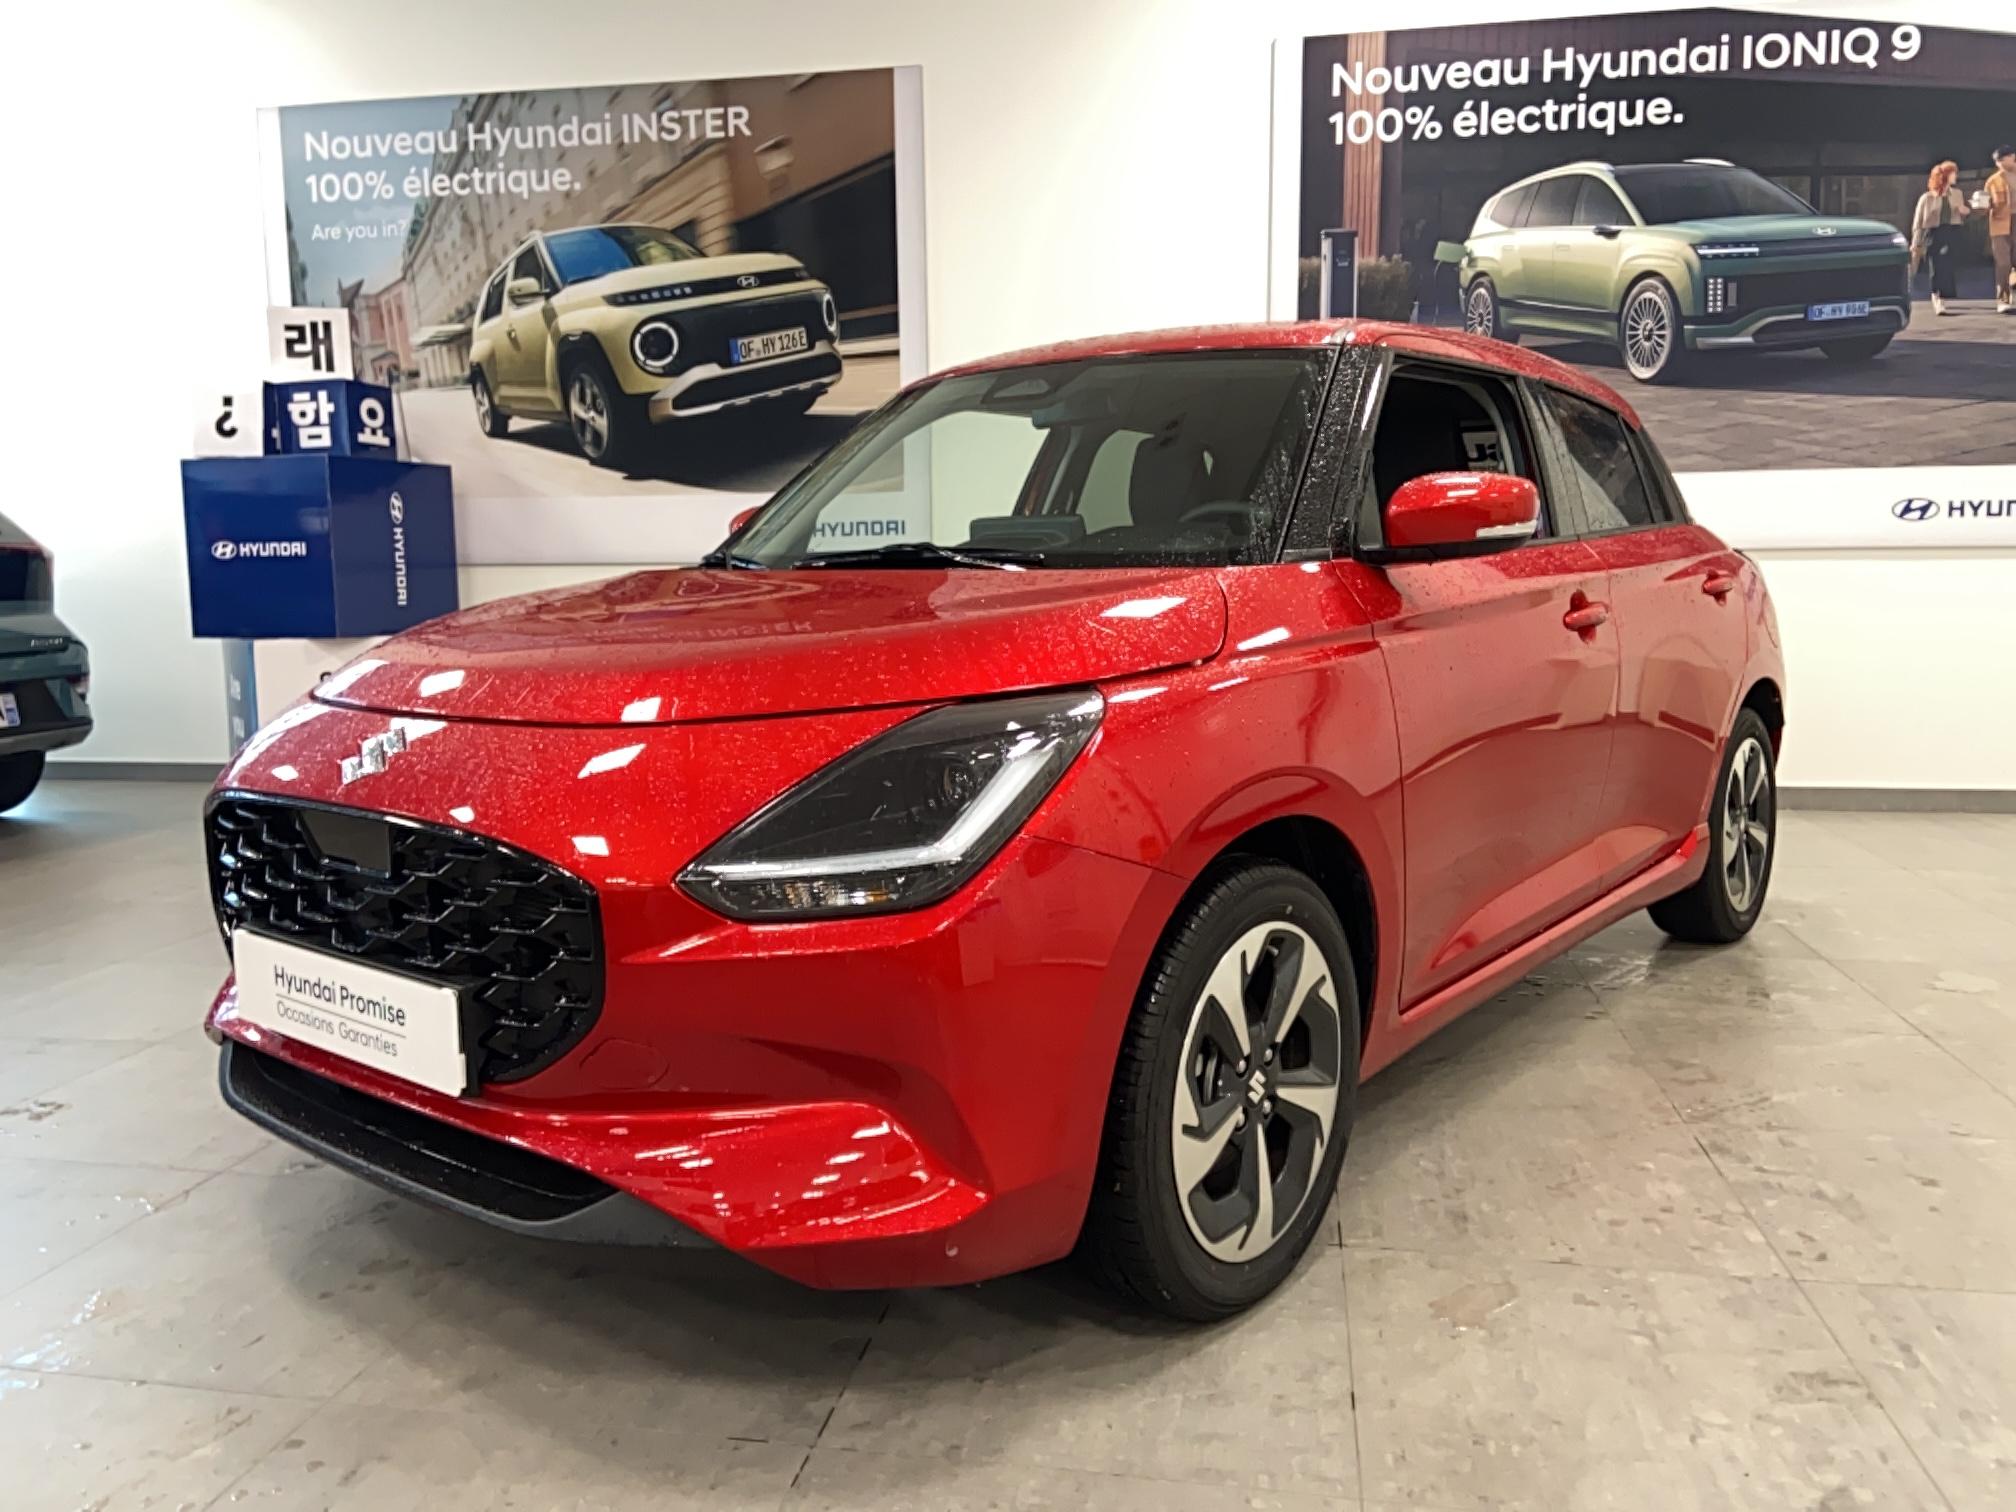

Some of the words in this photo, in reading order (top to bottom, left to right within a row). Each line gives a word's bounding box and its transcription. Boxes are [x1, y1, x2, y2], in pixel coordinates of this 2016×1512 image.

[1331, 56, 1530, 98] Nouveau
[1542, 33, 1730, 89] Hyundai
[1742, 27, 1880, 70] IONIQ
[1891, 24, 1922, 62] 9
[303, 129, 458, 162] Nouveau
[467, 112, 612, 157] Hyundai
[621, 105, 752, 144] INSTER
[1328, 104, 1443, 146] 100%
[1452, 92, 1684, 138] électrique.
[304, 169, 395, 204] 100%
[402, 161, 582, 200] électrique.
[312, 223, 342, 241] Are
[345, 223, 378, 243] you
[382, 218, 408, 238] in?
[284, 320, 335, 373] 래
[287, 389, 335, 449] 함
[357, 397, 391, 447] 요
[239, 541, 307, 558] HYUNDAI
[813, 519, 906, 538] HYUNDAI
[393, 526, 408, 606] HYUNDAI
[273, 964, 337, 1005] Hyundai
[339, 985, 406, 1027] Promise
[276, 1000, 335, 1035] Occasions
[338, 1021, 398, 1057] Garanties
